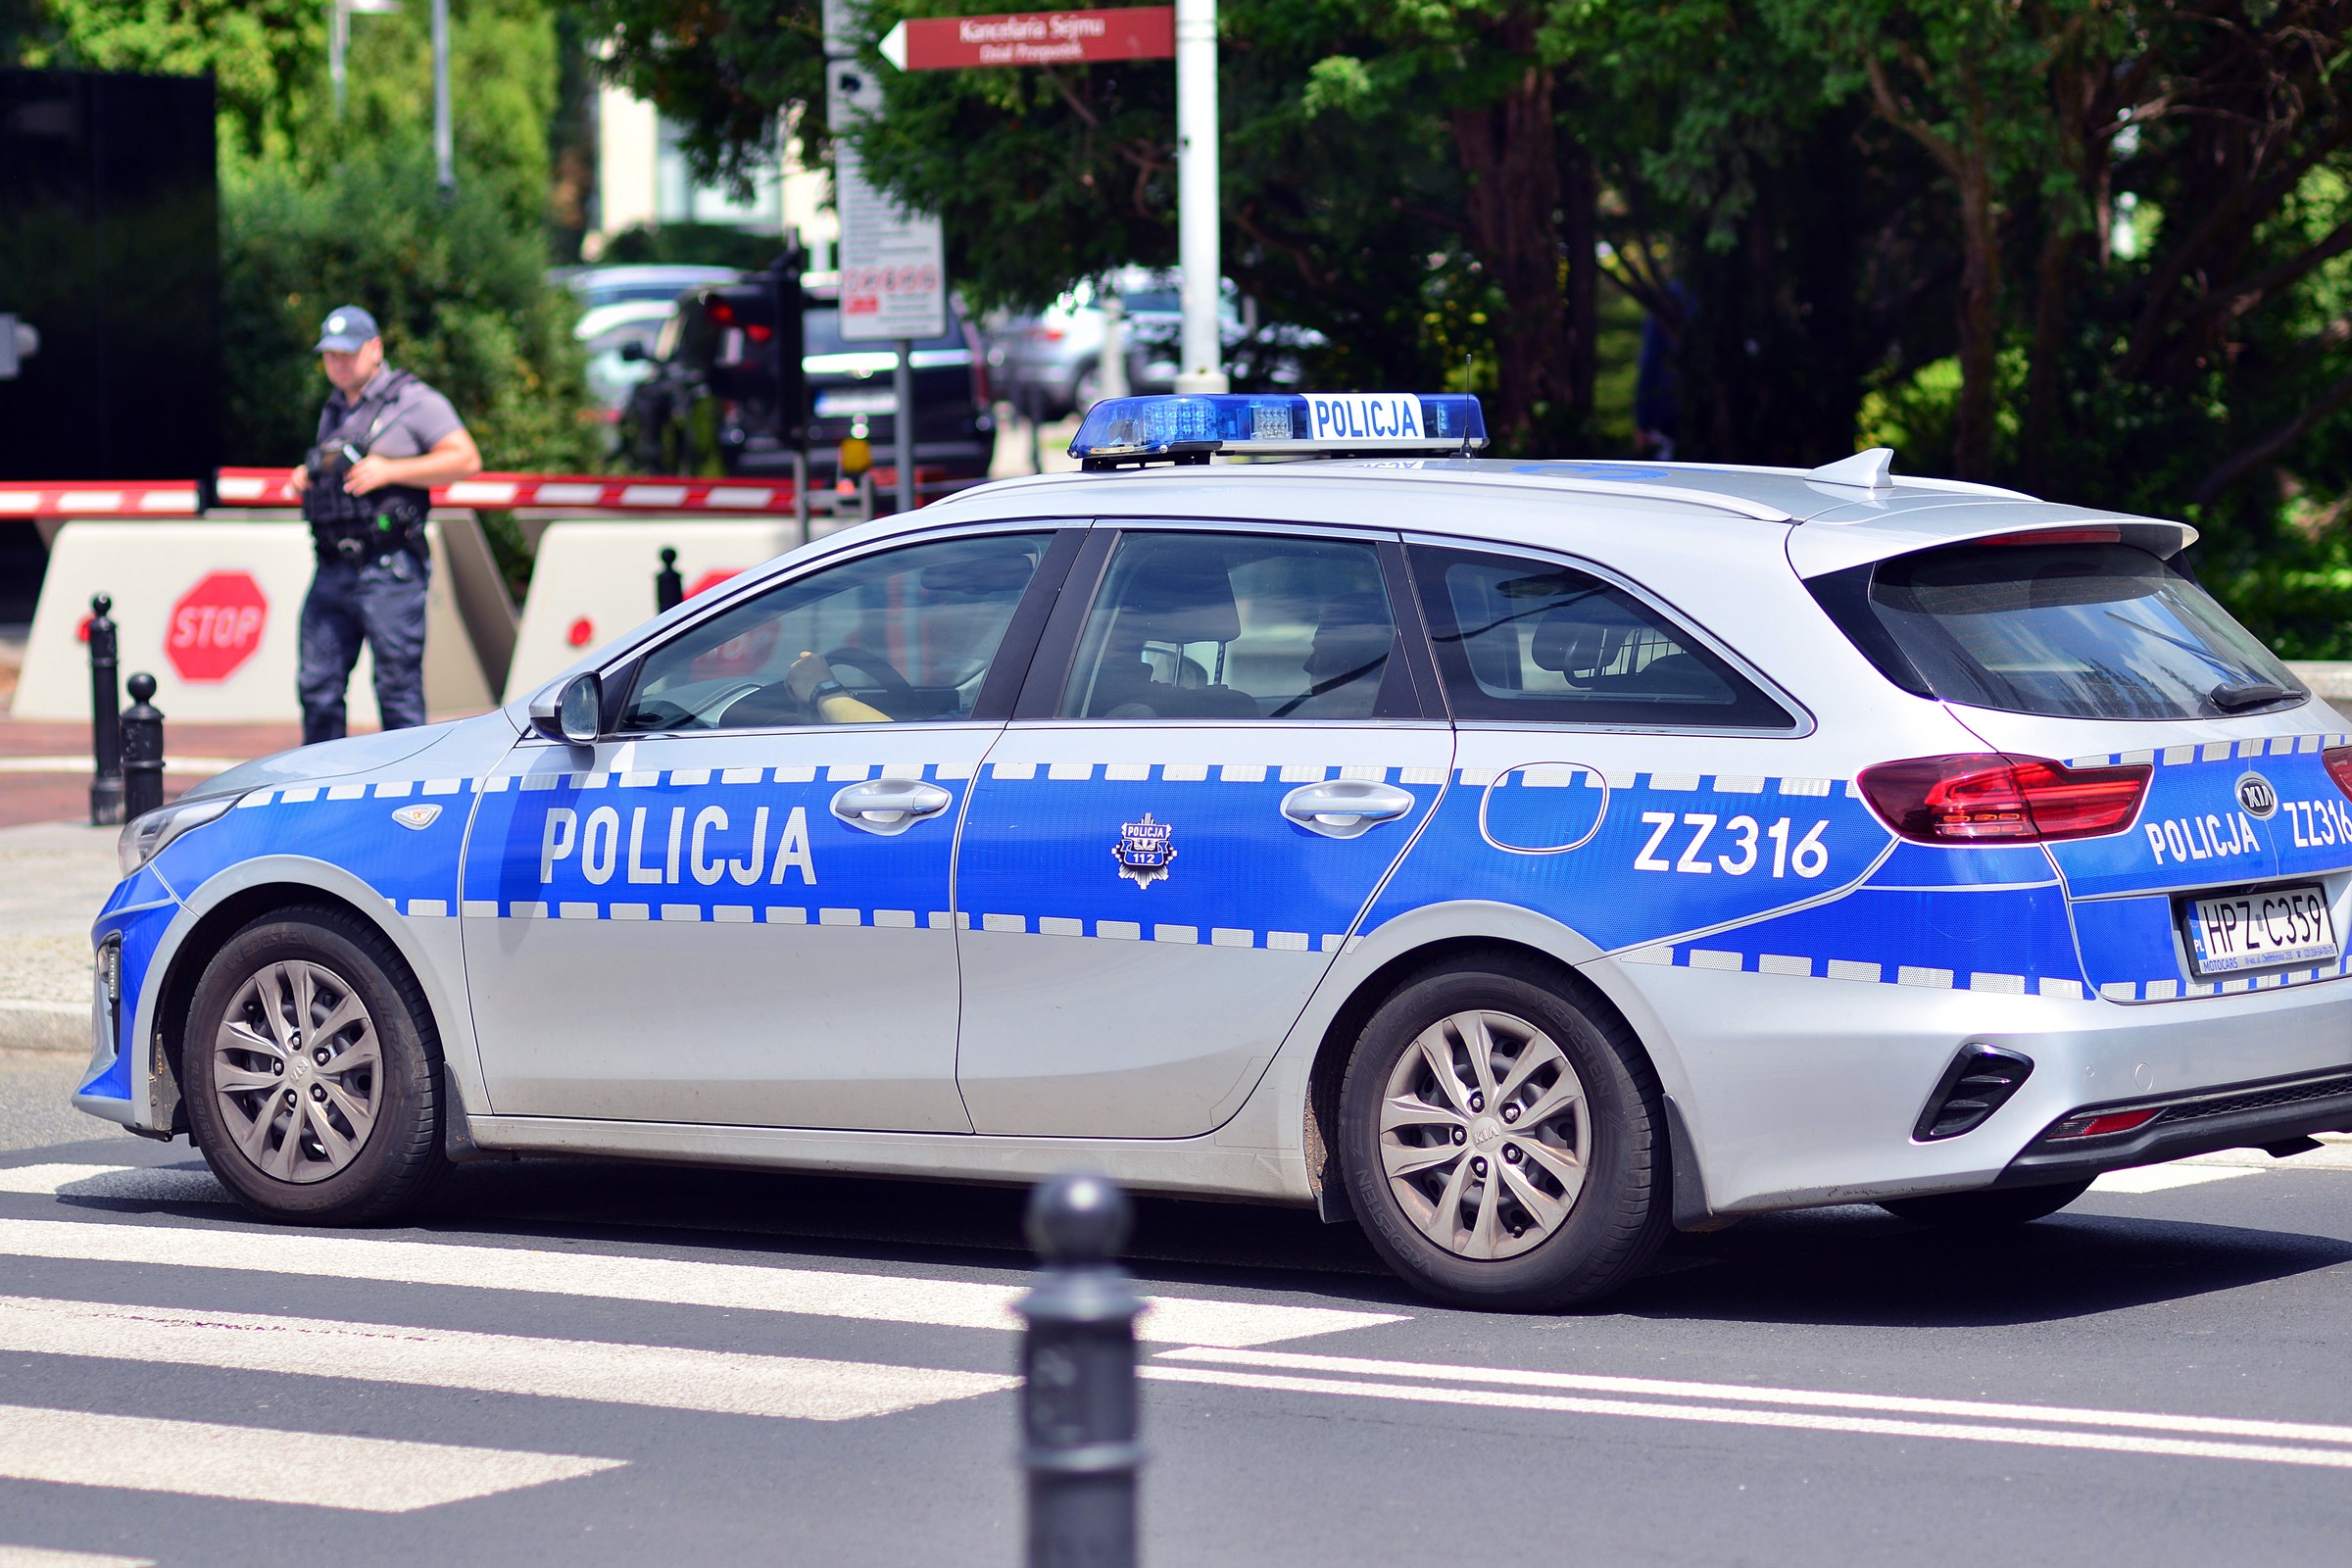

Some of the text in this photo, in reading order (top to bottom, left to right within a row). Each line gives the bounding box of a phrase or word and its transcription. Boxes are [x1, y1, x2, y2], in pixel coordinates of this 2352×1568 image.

[959, 15, 1105, 43] Kancelaria Sejmu
[1317, 400, 1418, 438] POLICJA
[172, 605, 262, 648] STOP
[2243, 785, 2274, 808] KIA
[540, 805, 817, 886] POLICJA
[1127, 826, 1164, 838] POLICJA
[1634, 811, 1830, 878] ZZ316
[2144, 811, 2261, 864] POLICJA
[1133, 853, 1155, 863] 112
[2203, 894, 2322, 955] HPZ C359
[2193, 939, 2205, 953] PL
[2203, 957, 2238, 971] MOTOCARS
[1531, 989, 1612, 1099] VREDESTEIN
[1473, 1125, 1499, 1145] KIA
[1355, 1168, 1433, 1277] VREDESTEIN
